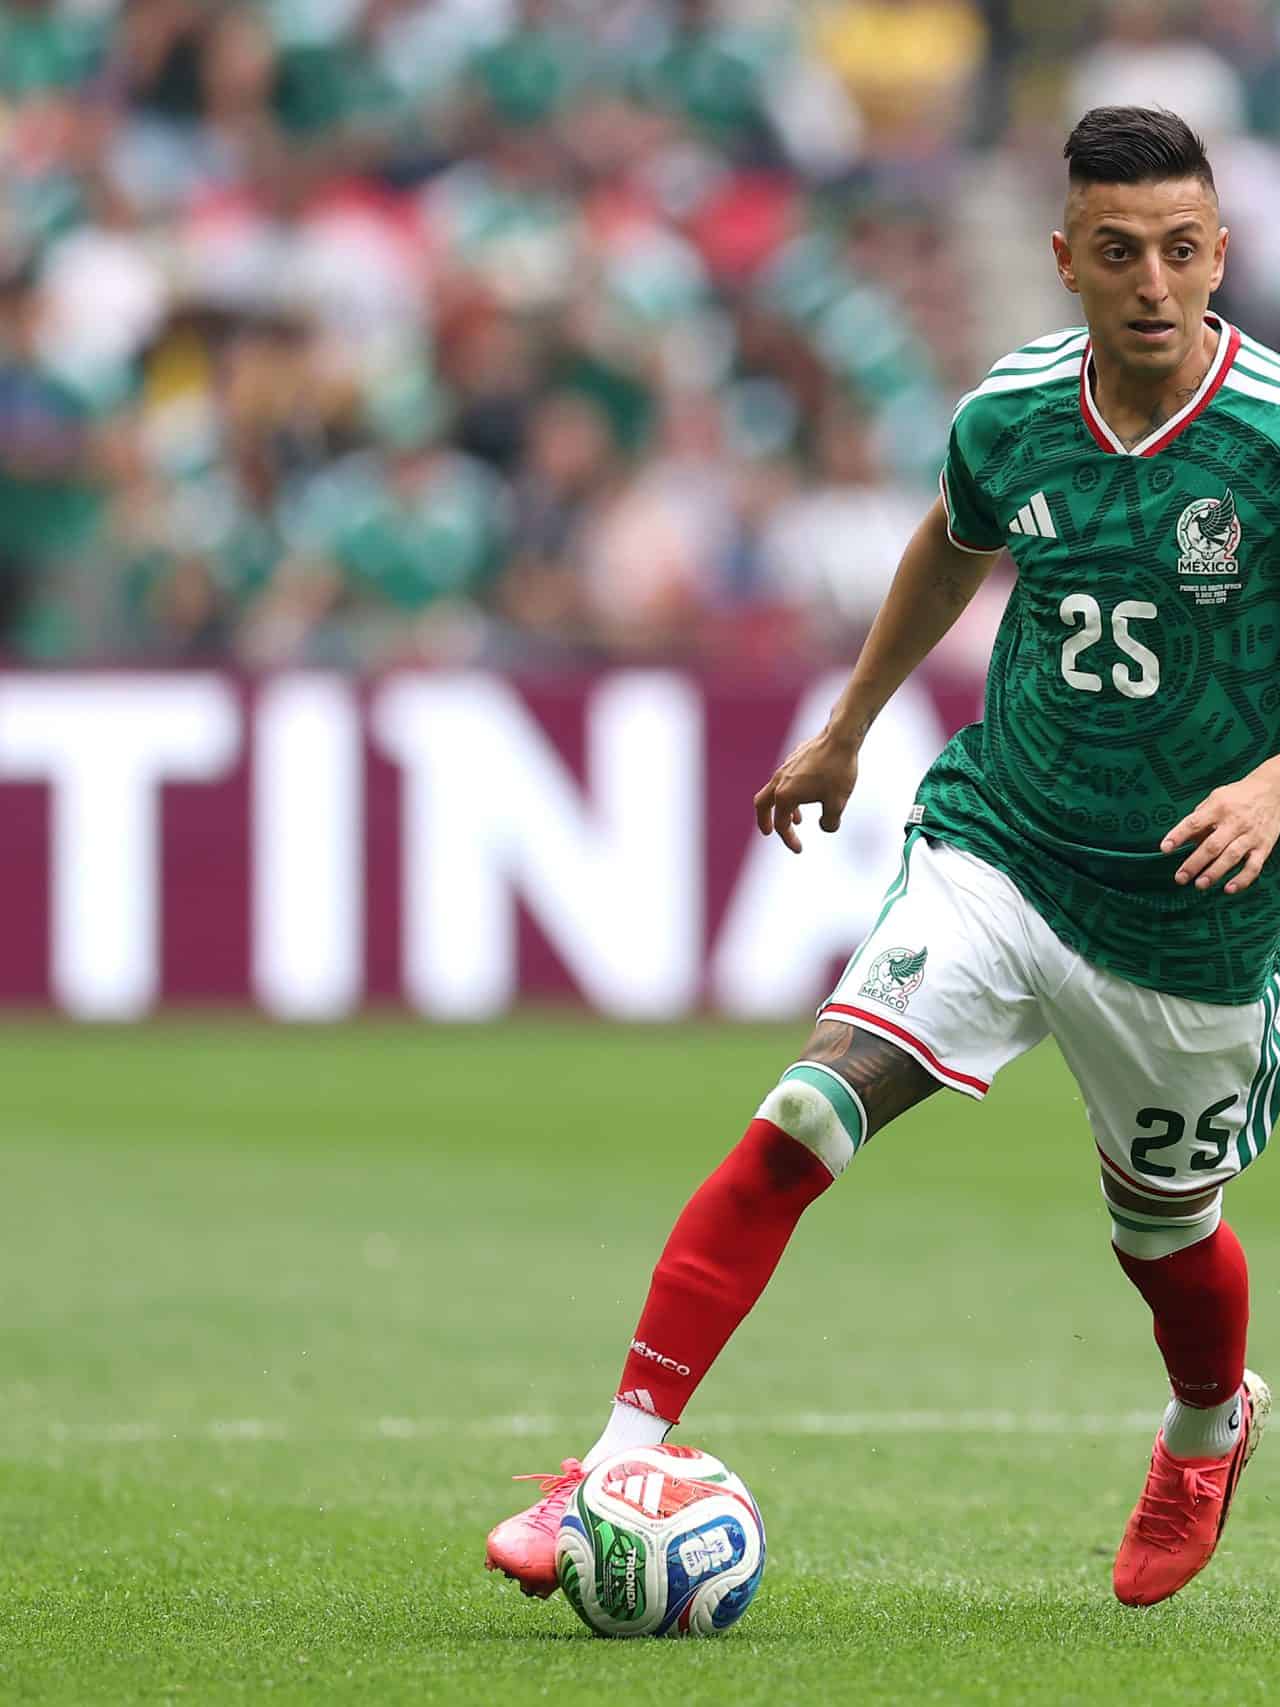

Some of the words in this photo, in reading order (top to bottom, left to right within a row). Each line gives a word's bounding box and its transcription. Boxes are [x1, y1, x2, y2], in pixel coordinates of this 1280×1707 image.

[1179, 559, 1236, 572] MÉXICO
[1059, 593, 1161, 699] 25
[863, 986, 905, 1009] MÉXICO
[1130, 1094, 1240, 1178] 25
[625, 1547, 637, 1610] TRIONDA
